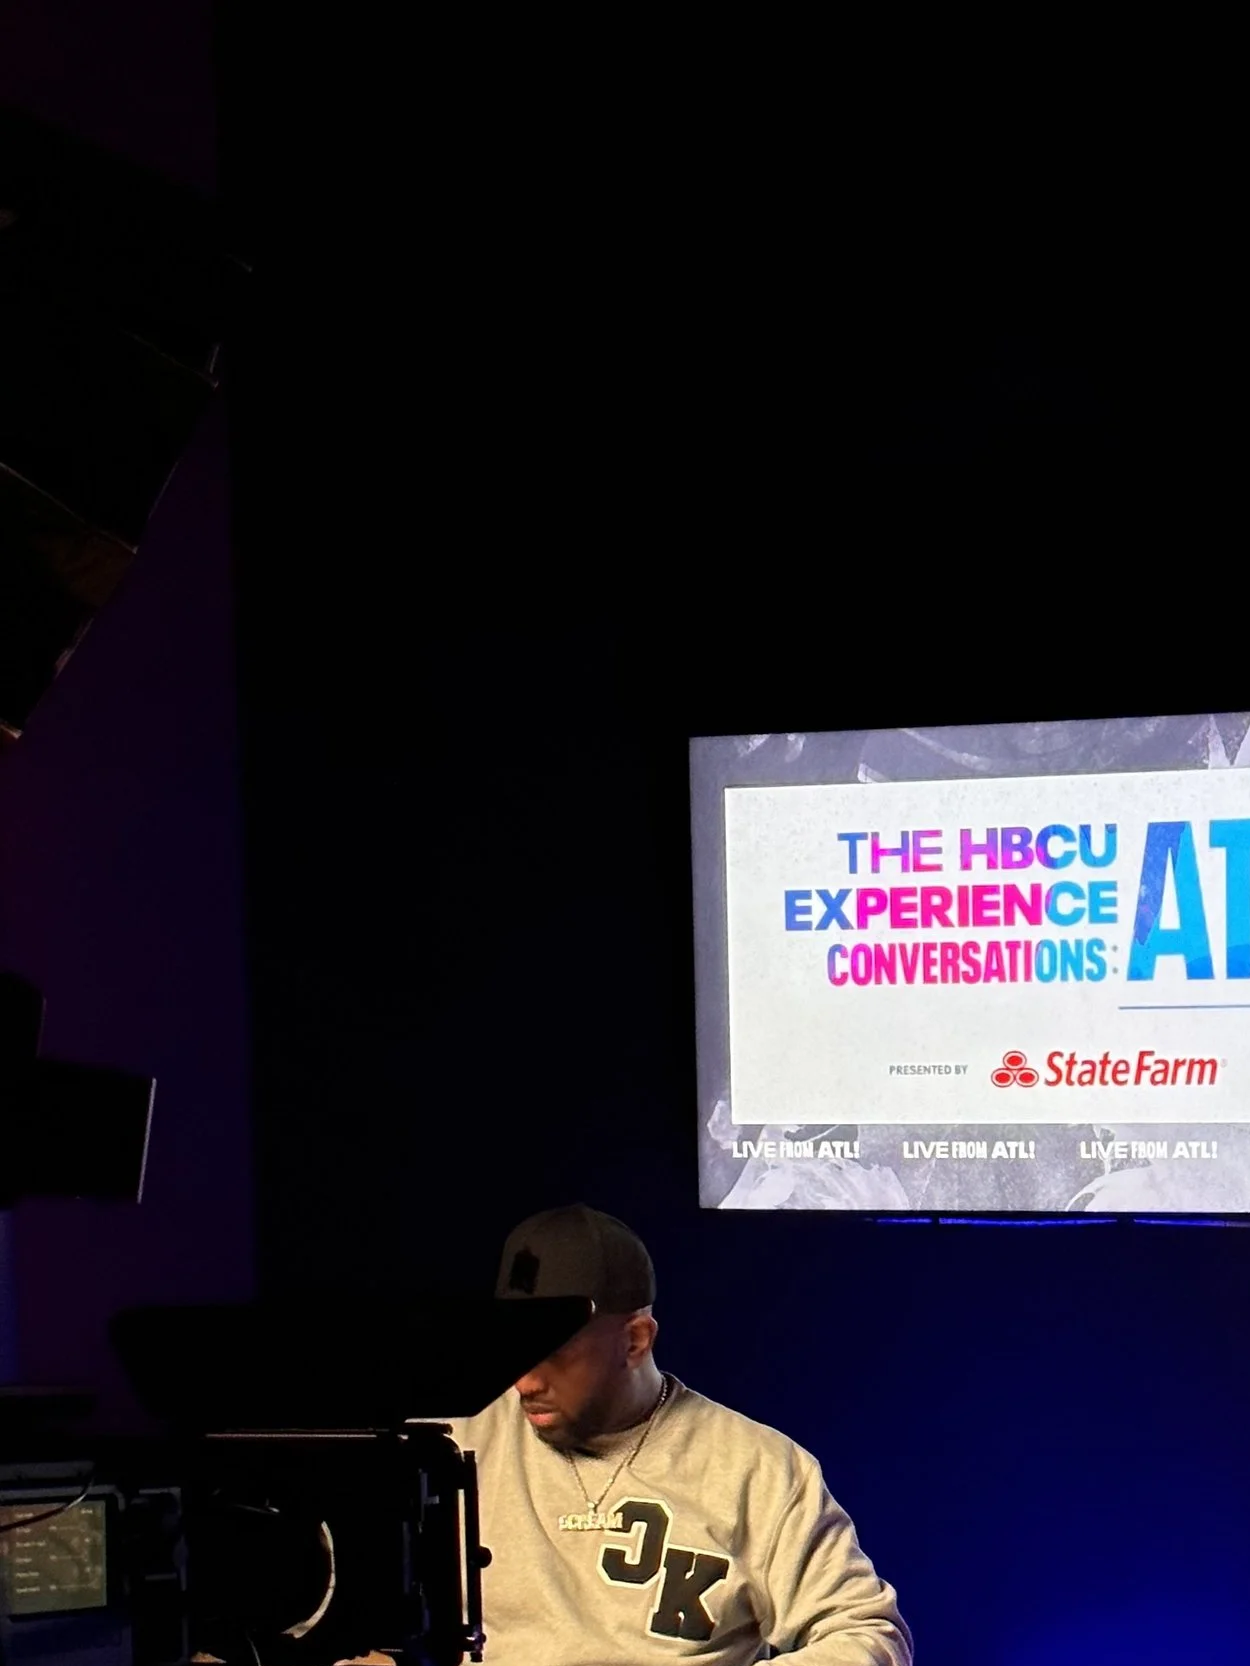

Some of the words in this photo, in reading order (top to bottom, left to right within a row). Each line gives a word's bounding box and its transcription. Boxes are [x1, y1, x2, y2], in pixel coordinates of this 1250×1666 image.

[837, 829, 943, 874] THE
[959, 823, 1118, 871] HBCU
[784, 880, 1119, 931] EXPERIENCE
[889, 1064, 951, 1076] PRESENTED
[952, 1064, 969, 1076] BY
[732, 1141, 777, 1159] LIVE
[779, 1141, 814, 1159] FROM
[817, 1140, 861, 1159] ATL!
[902, 1141, 949, 1159] LIVE
[951, 1141, 988, 1159] FROM
[991, 1140, 1036, 1159] ATL!
[1079, 1141, 1129, 1159] LIVE
[1131, 1141, 1168, 1159] FROM
[1171, 1140, 1218, 1159] ATL!
